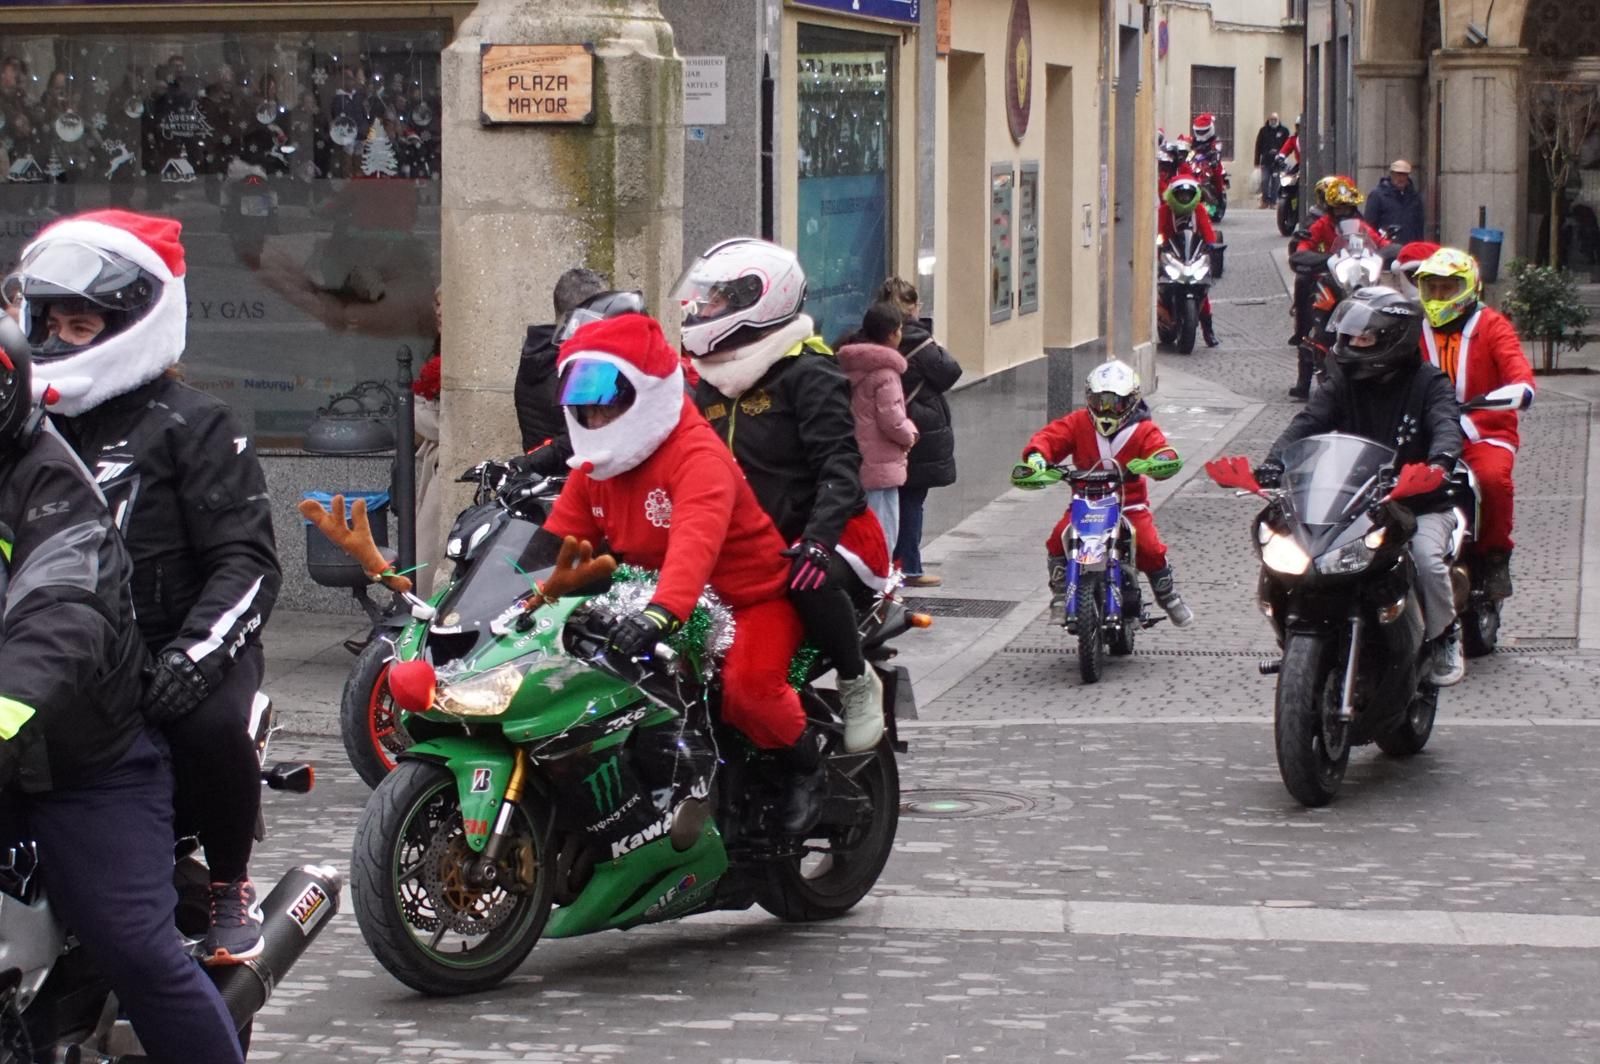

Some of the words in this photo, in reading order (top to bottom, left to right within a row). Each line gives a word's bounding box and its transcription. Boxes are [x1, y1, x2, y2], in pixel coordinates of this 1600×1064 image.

[508, 75, 568, 91] PLAZA
[508, 98, 568, 114] MAYOR
[201, 302, 212, 318] Y
[221, 302, 265, 319] GAS
[243, 379, 295, 391] Naturgy
[27, 501, 70, 522] LS2
[611, 776, 709, 859] Kawaki
[294, 889, 321, 921] IXIL
